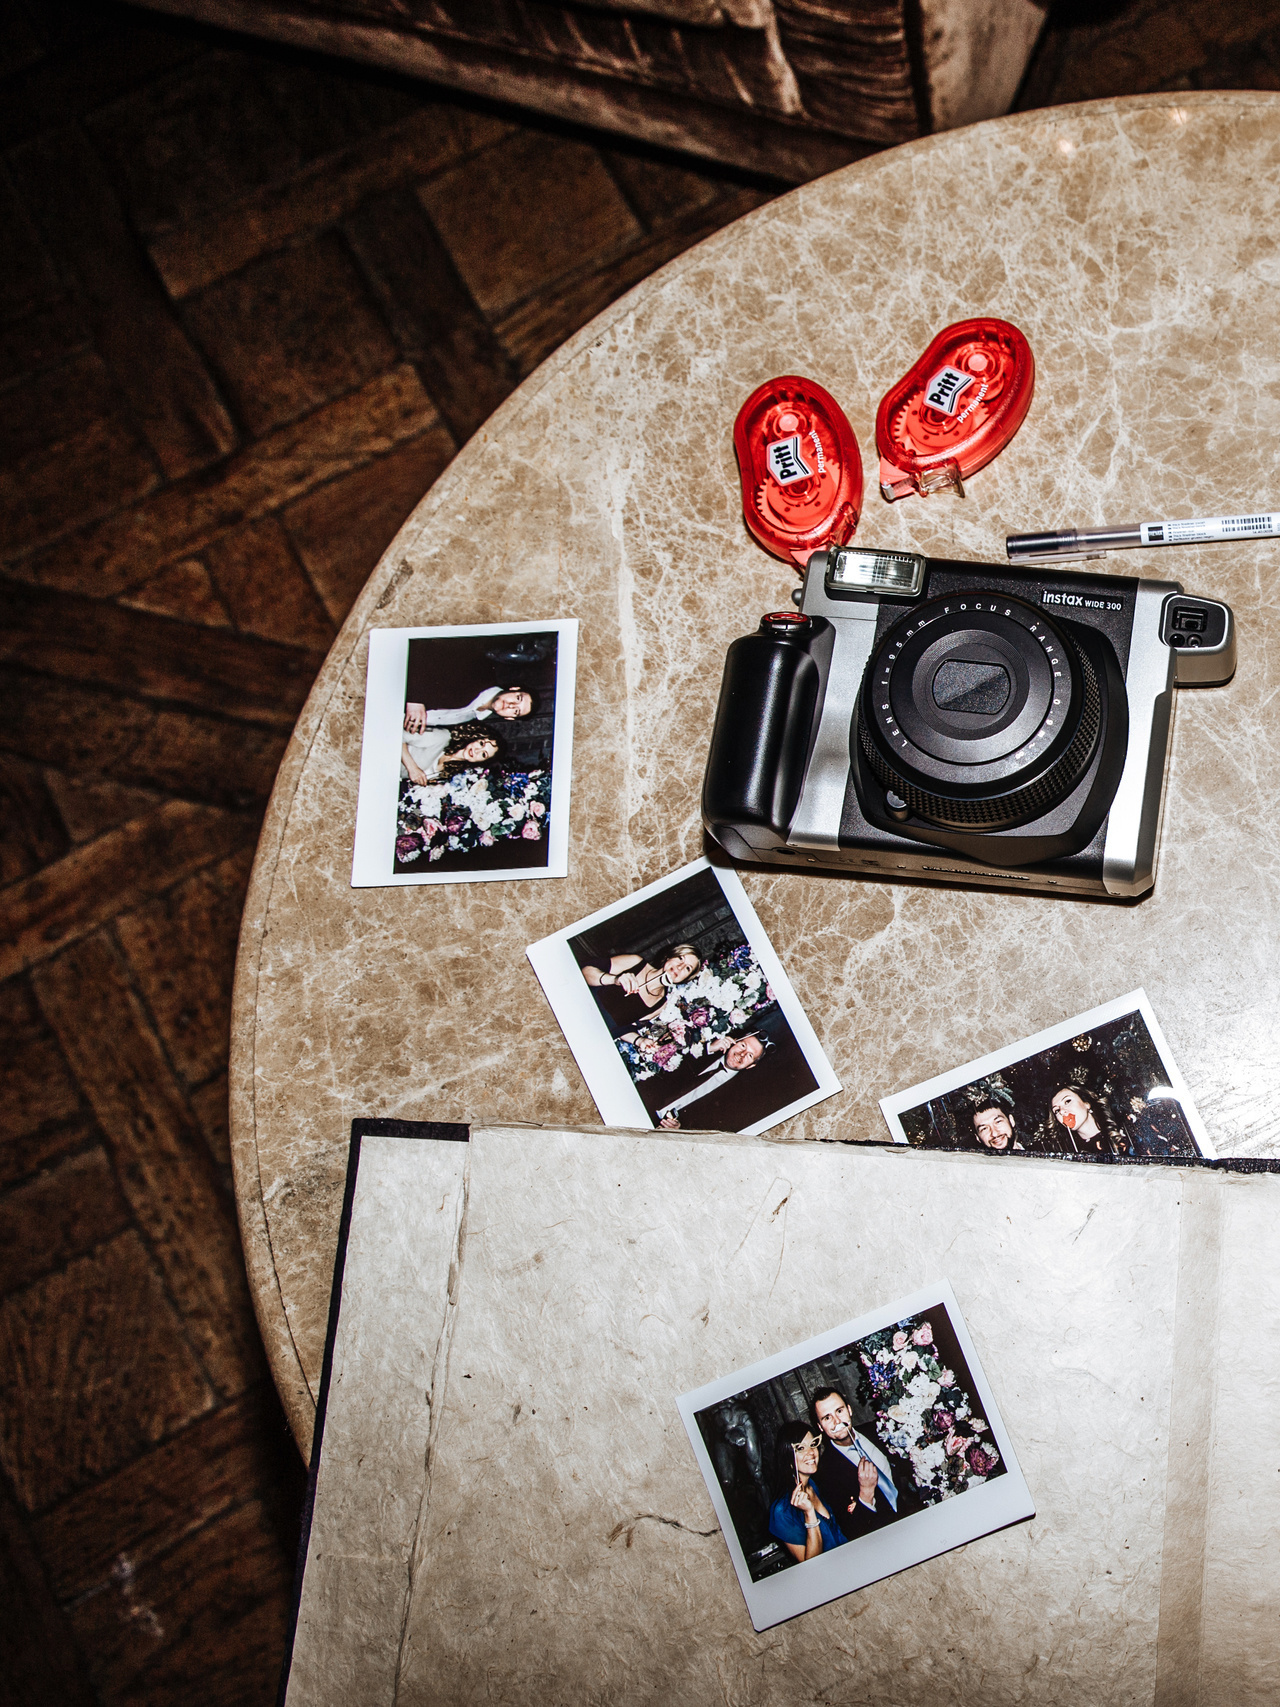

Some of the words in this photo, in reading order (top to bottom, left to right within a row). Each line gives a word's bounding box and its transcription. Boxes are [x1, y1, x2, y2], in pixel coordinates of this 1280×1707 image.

[928, 372, 960, 406] Pritt
[956, 383, 989, 424] permanent
[773, 444, 798, 480] Pritt
[808, 430, 827, 474] permanent
[1042, 590, 1084, 607] instax
[1084, 599, 1105, 609] WIDE
[1106, 601, 1122, 611] 300
[881, 702, 909, 748] LENS
[943, 602, 1013, 617] FOCUS
[1029, 624, 1062, 678] RANGE
